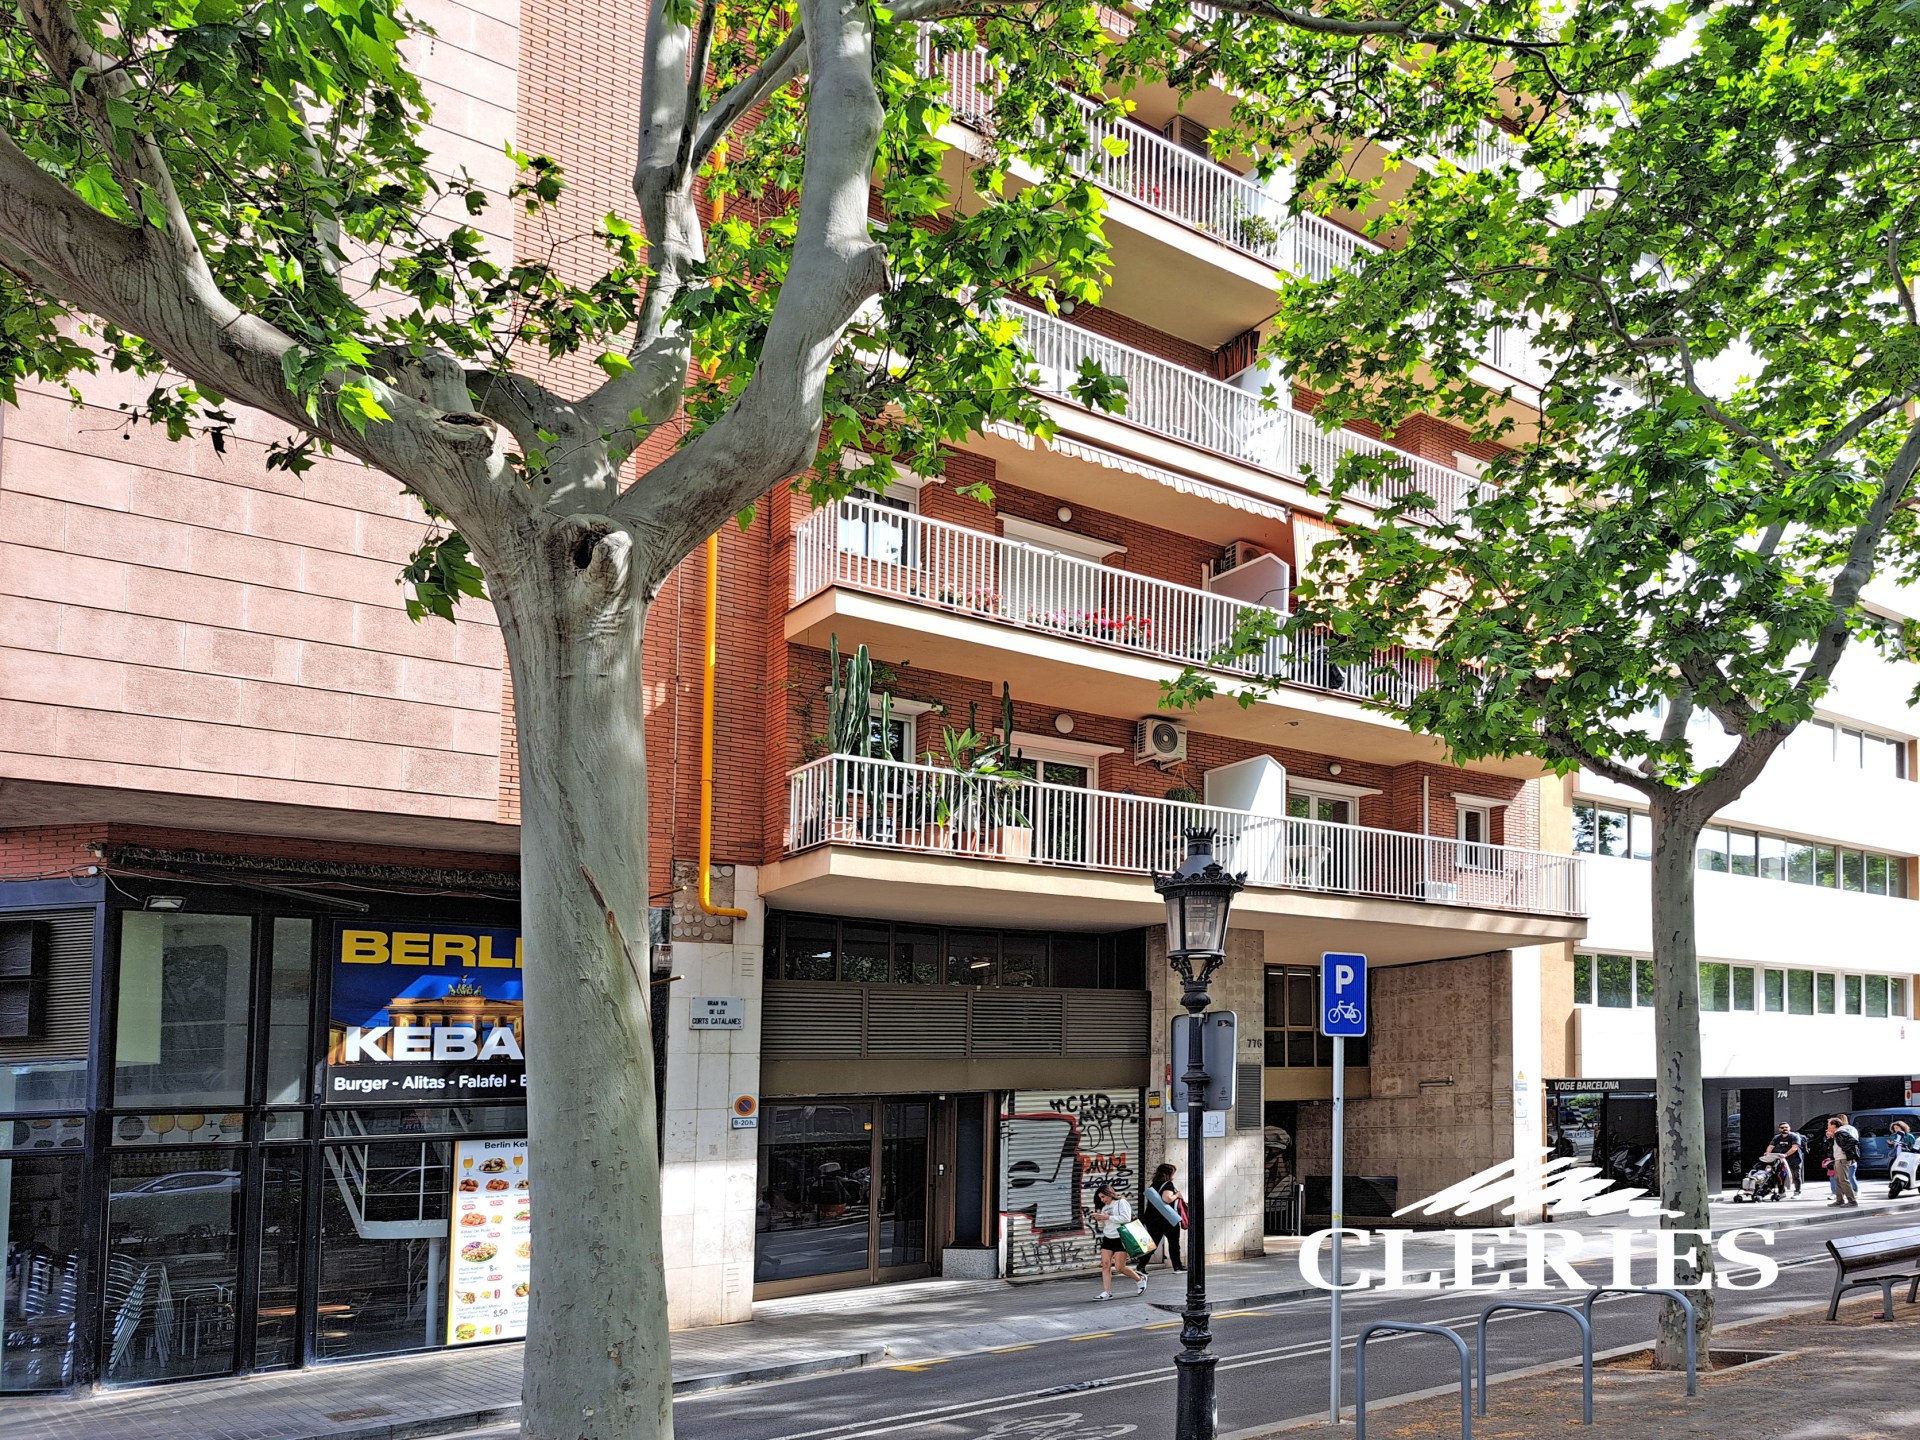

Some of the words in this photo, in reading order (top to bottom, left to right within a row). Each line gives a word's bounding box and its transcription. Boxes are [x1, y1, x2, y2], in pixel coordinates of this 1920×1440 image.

[1335, 964, 1354, 994] P
[691, 1017, 709, 1025] CORTS
[710, 1017, 742, 1025] CATALANES
[345, 1026, 525, 1062] KEBA
[1246, 1038, 1263, 1049] 776
[334, 1076, 390, 1093] Burger
[402, 1075, 446, 1090] Alitas
[459, 1074, 507, 1088] Falafel
[1554, 1081, 1576, 1091] VOGE
[1576, 1080, 1620, 1090] BARCELONA
[484, 1141, 511, 1149] Berlin
